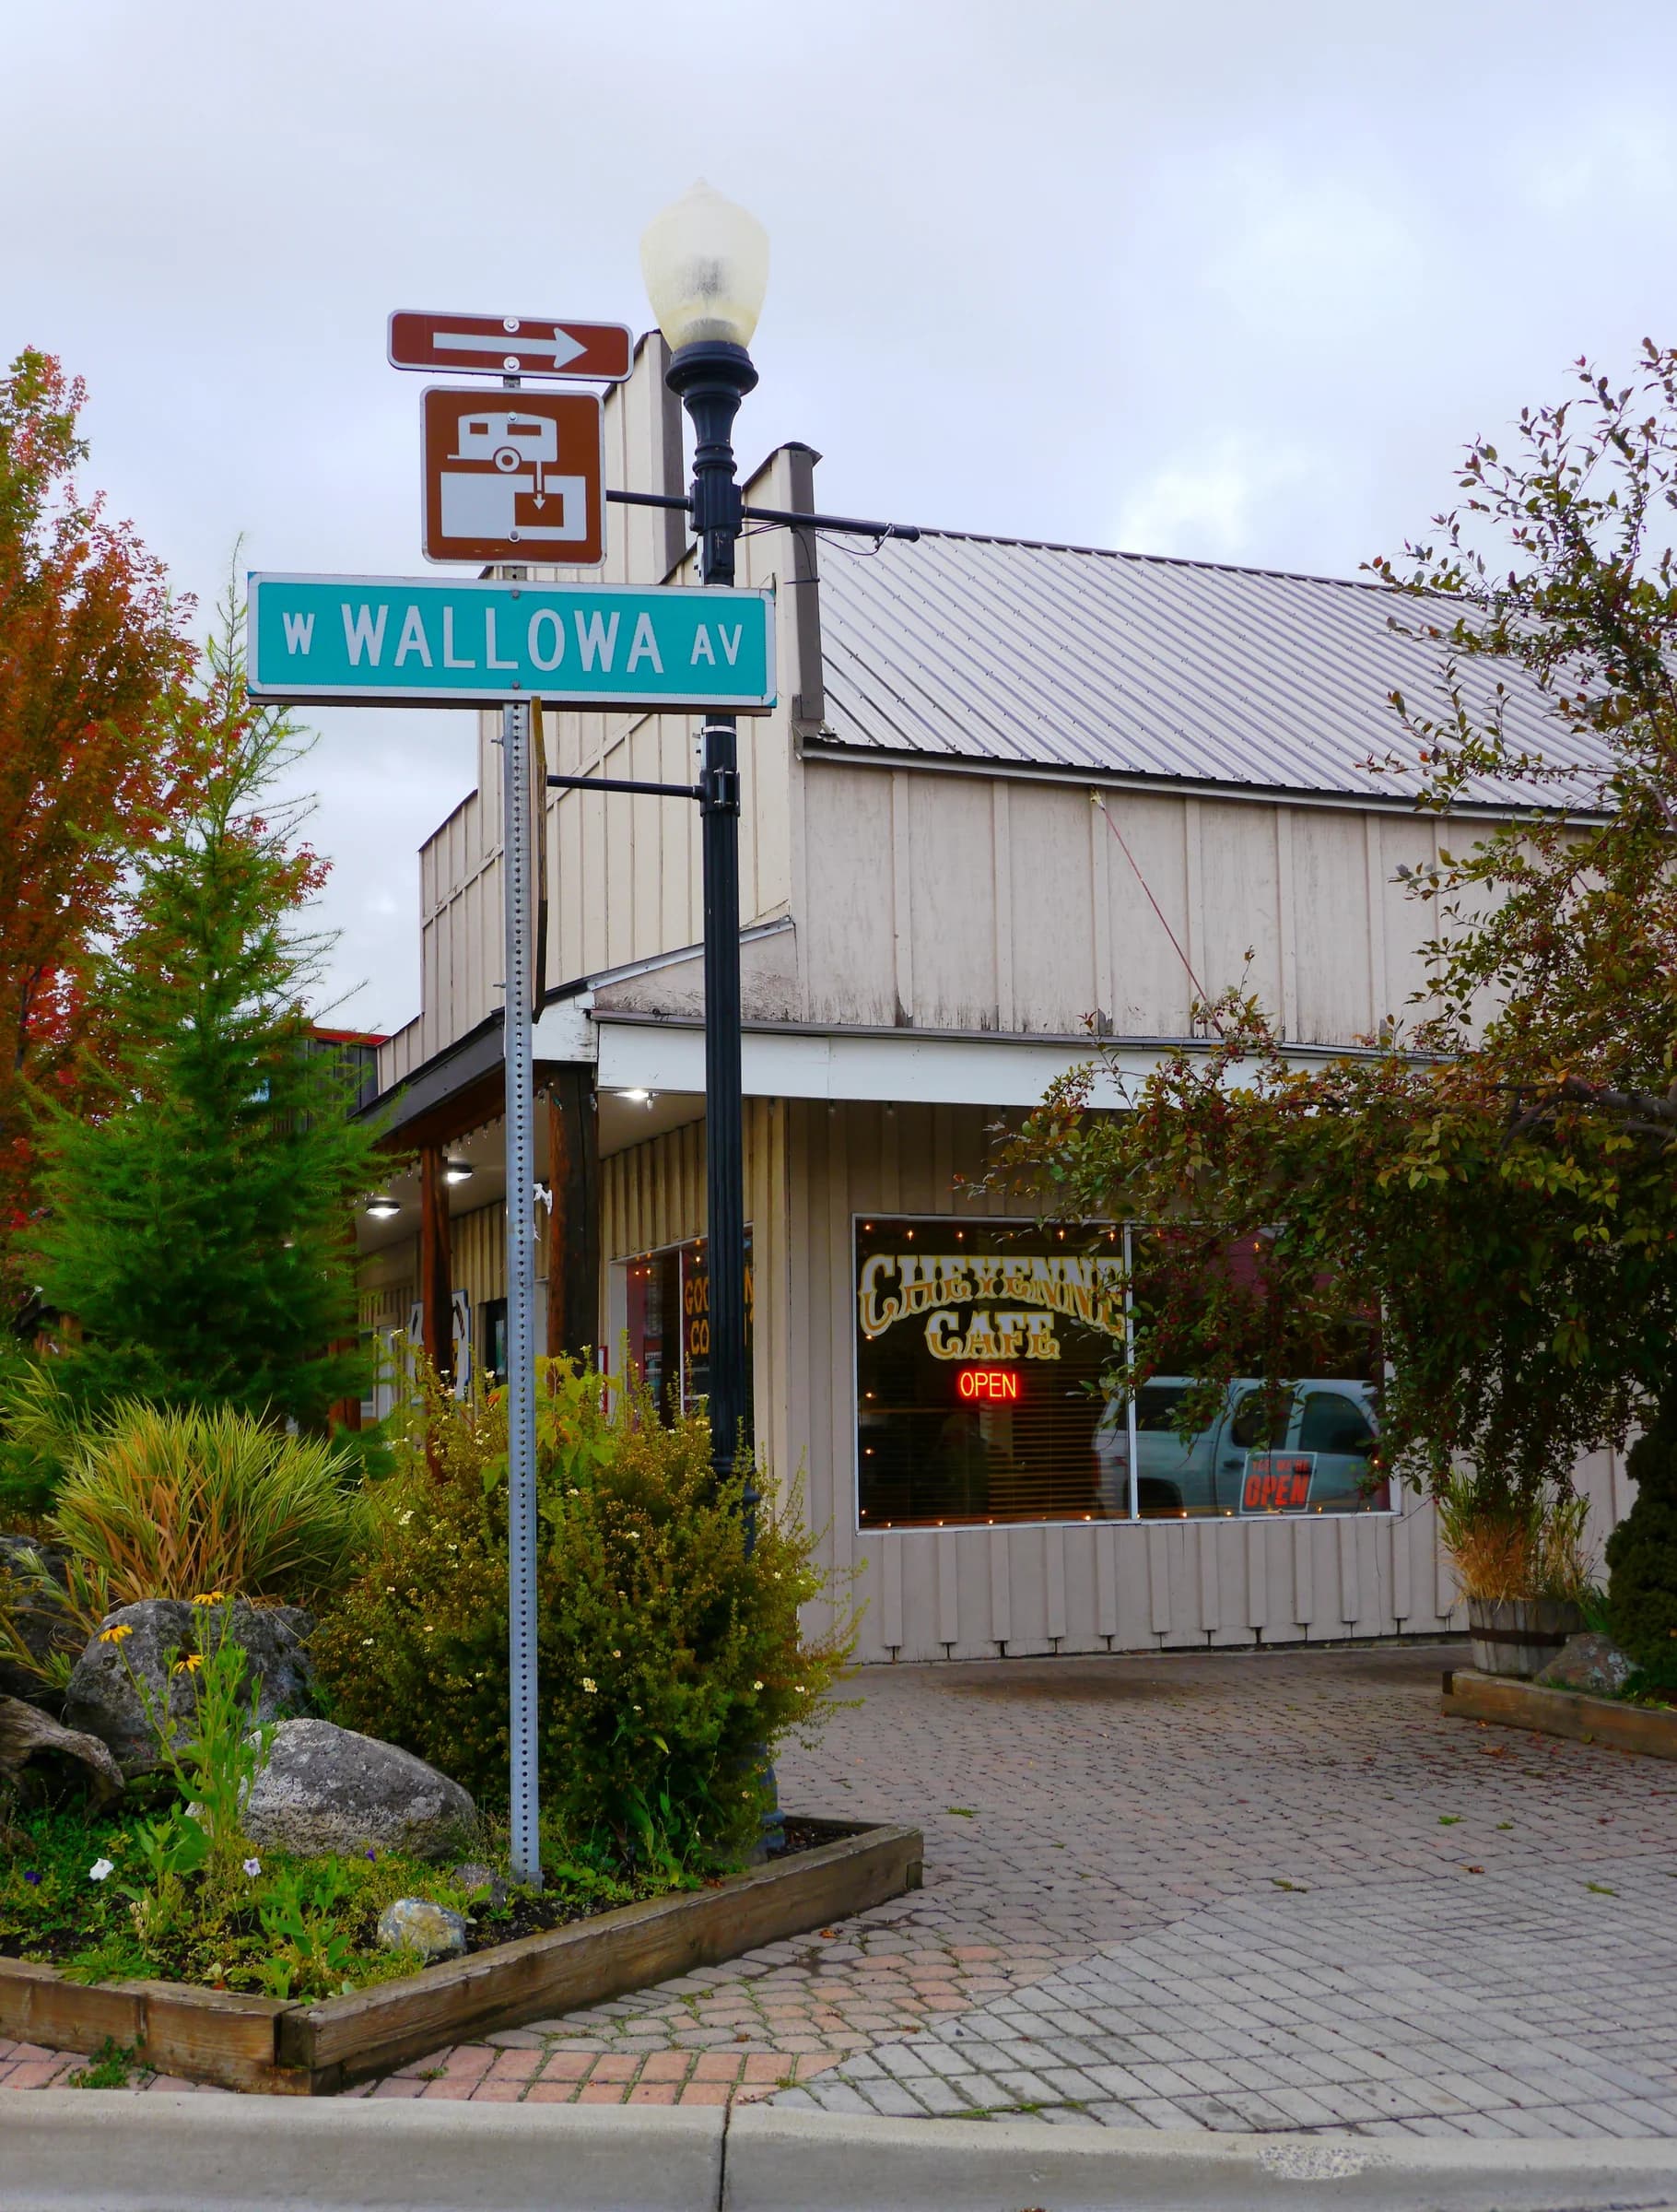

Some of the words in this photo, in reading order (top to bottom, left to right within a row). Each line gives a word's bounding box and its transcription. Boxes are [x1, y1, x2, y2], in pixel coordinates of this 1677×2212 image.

[282, 612, 316, 655] W
[340, 603, 665, 674] WALLOWA
[690, 623, 744, 665] AV
[858, 1253, 1126, 1342] CHEYENNE
[924, 1310, 1062, 1360] CAFE
[959, 1371, 1017, 1398] OPEN
[1244, 1474, 1309, 1508] OPEN
